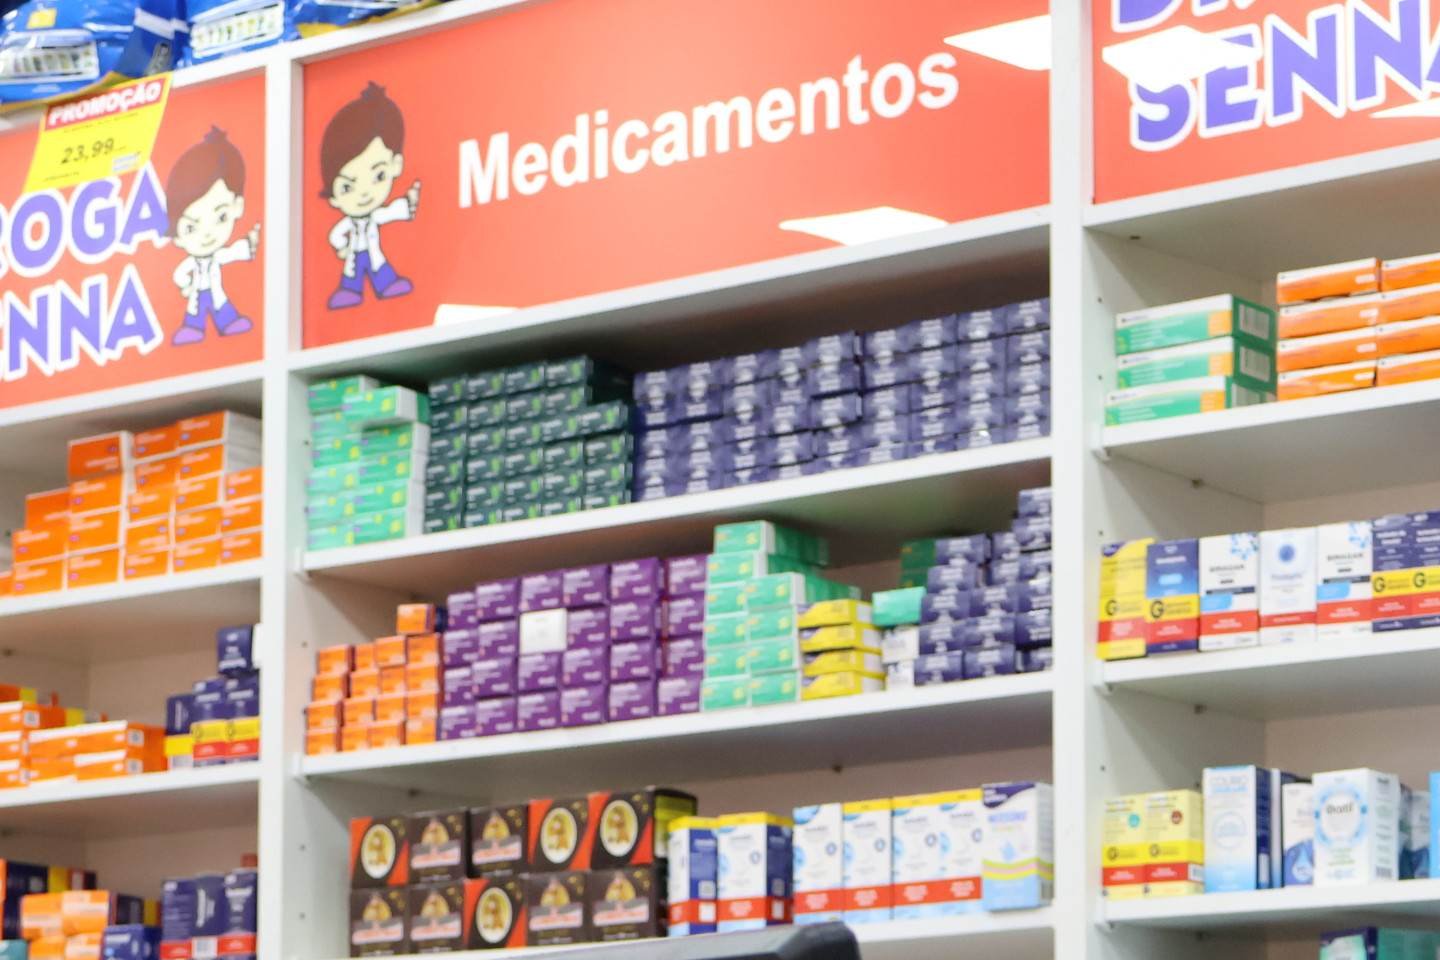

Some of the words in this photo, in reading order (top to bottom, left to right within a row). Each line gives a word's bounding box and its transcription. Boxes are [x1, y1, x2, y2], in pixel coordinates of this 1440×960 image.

[48, 81, 162, 127] PROMOÇÃO
[60, 138, 115, 165] 23,99
[458, 52, 959, 208] Medicamentos
[0, 163, 172, 277] OGA
[0, 268, 163, 380] NNA
